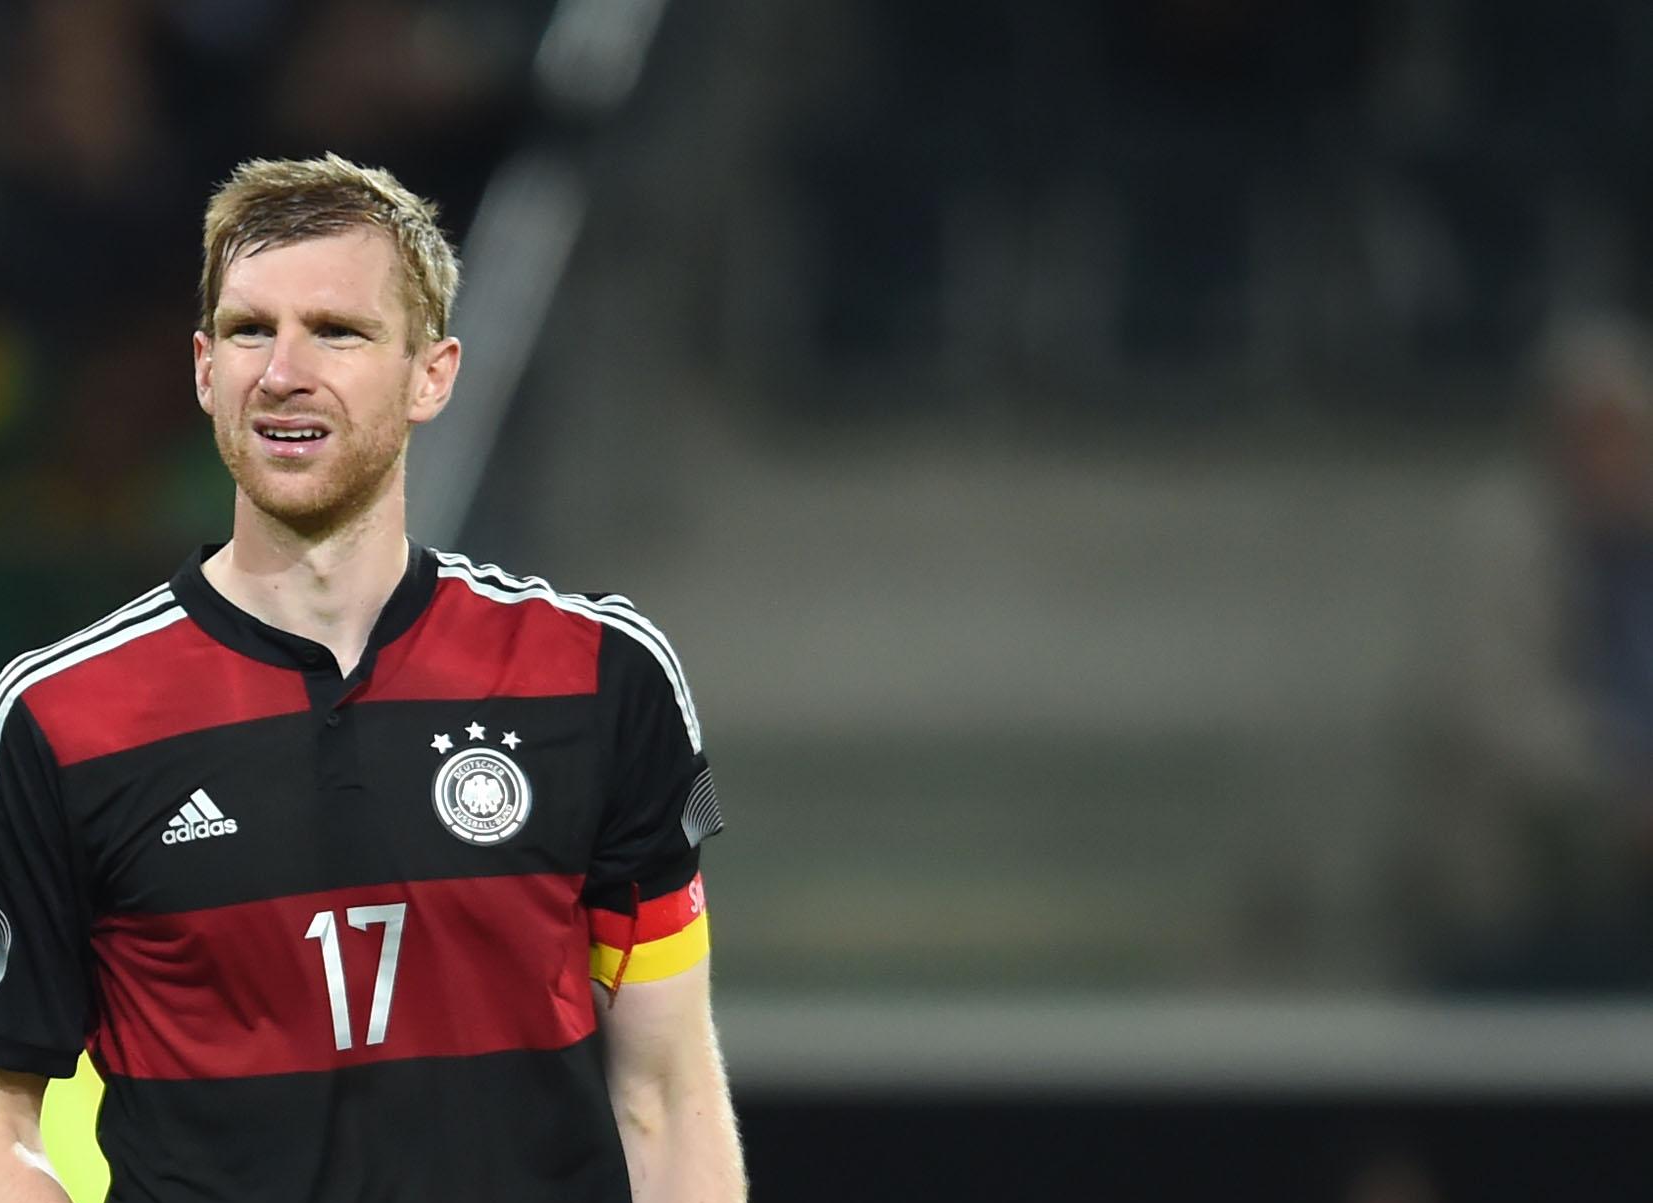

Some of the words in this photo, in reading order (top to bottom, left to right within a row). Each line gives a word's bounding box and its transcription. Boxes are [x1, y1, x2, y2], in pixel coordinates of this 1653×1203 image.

[453, 760, 506, 781] DEUTSCHER
[161, 816, 238, 845] adidas
[304, 902, 407, 1051] 17
